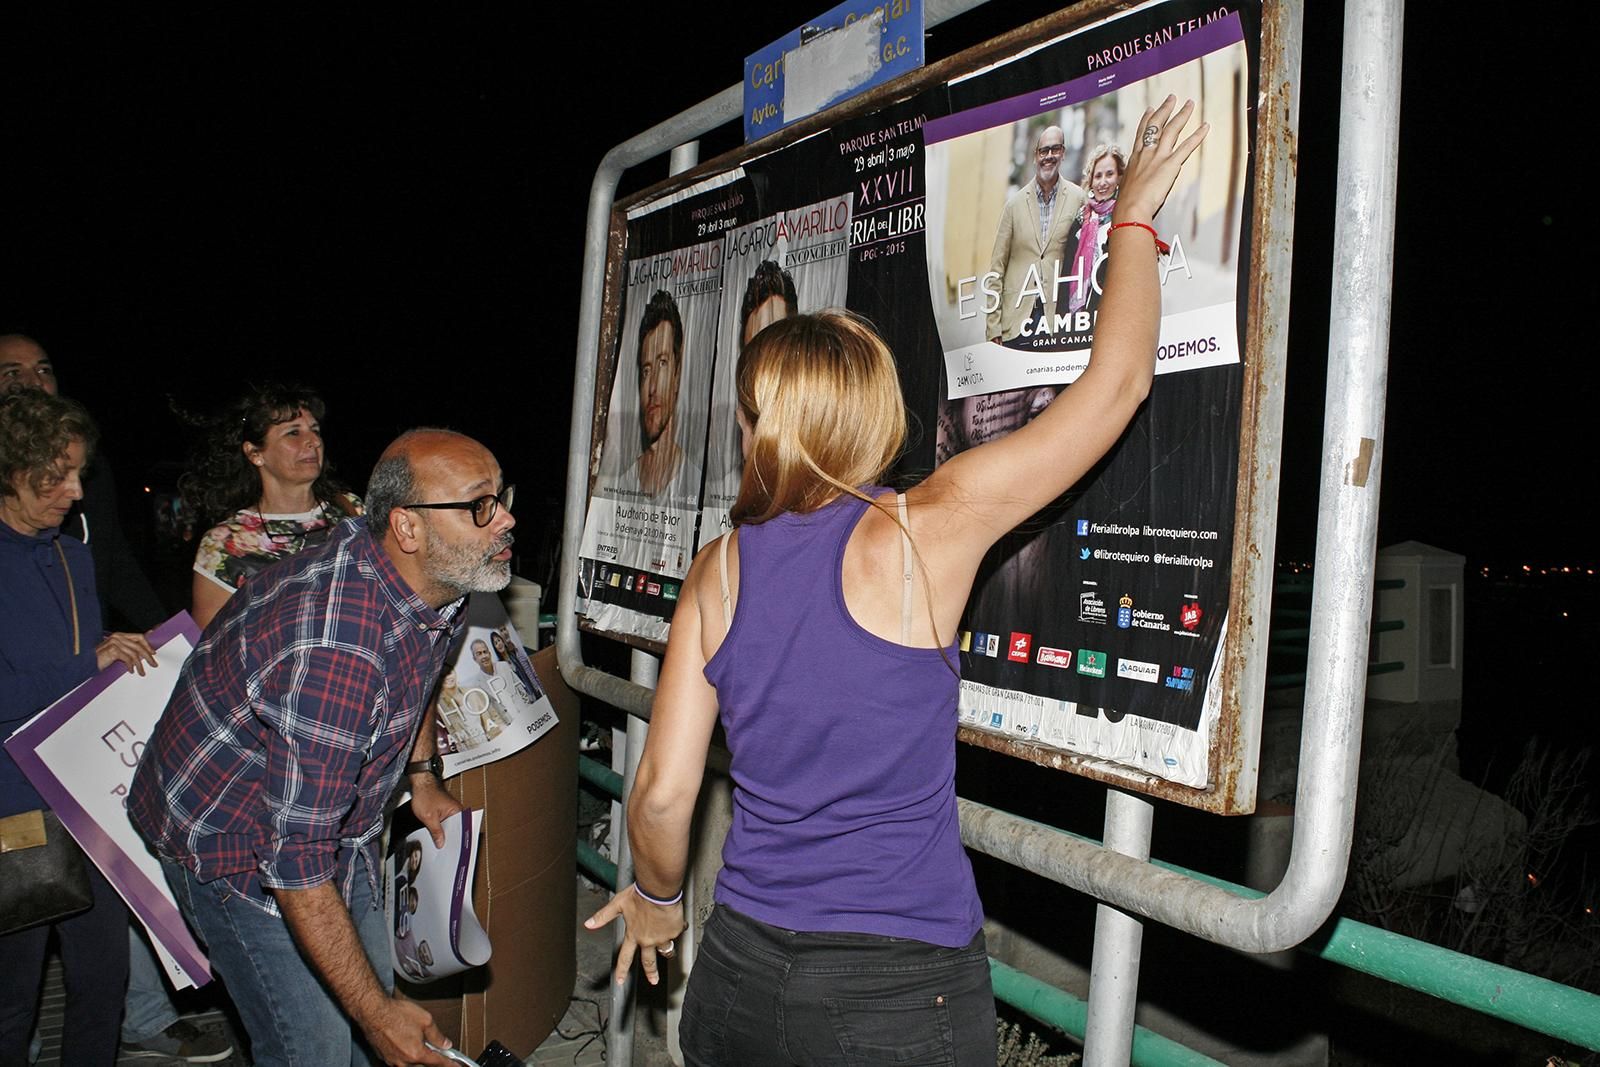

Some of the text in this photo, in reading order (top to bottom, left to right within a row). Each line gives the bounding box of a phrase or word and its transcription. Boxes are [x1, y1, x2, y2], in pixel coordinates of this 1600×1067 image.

[1087, 38, 1142, 71] PARQUE
[1145, 26, 1172, 50] SAN
[752, 103, 778, 124] Ayto.
[883, 36, 910, 63] G.C.
[840, 132, 876, 155] PARQUE
[878, 127, 897, 143] SAN
[854, 156, 865, 173] 29
[896, 143, 915, 159] mayo
[859, 166, 913, 207] XXVII
[849, 217, 877, 247] ERIA
[887, 203, 926, 237] LIBR
[886, 241, 905, 256] 2015
[957, 271, 1001, 321] ES
[1033, 335, 1094, 348] GRAN CANAR
[1157, 336, 1221, 361] ODEMOS.
[1090, 522, 1140, 538] /ferialibrolpa
[1143, 525, 1218, 540] librotequiero.com
[1093, 549, 1214, 569] @librotequiero @ferialibrolpa
[1131, 619, 1171, 632] de Canarias
[1132, 609, 1164, 621] Gobierno
[1128, 665, 1157, 676] AGUIAR
